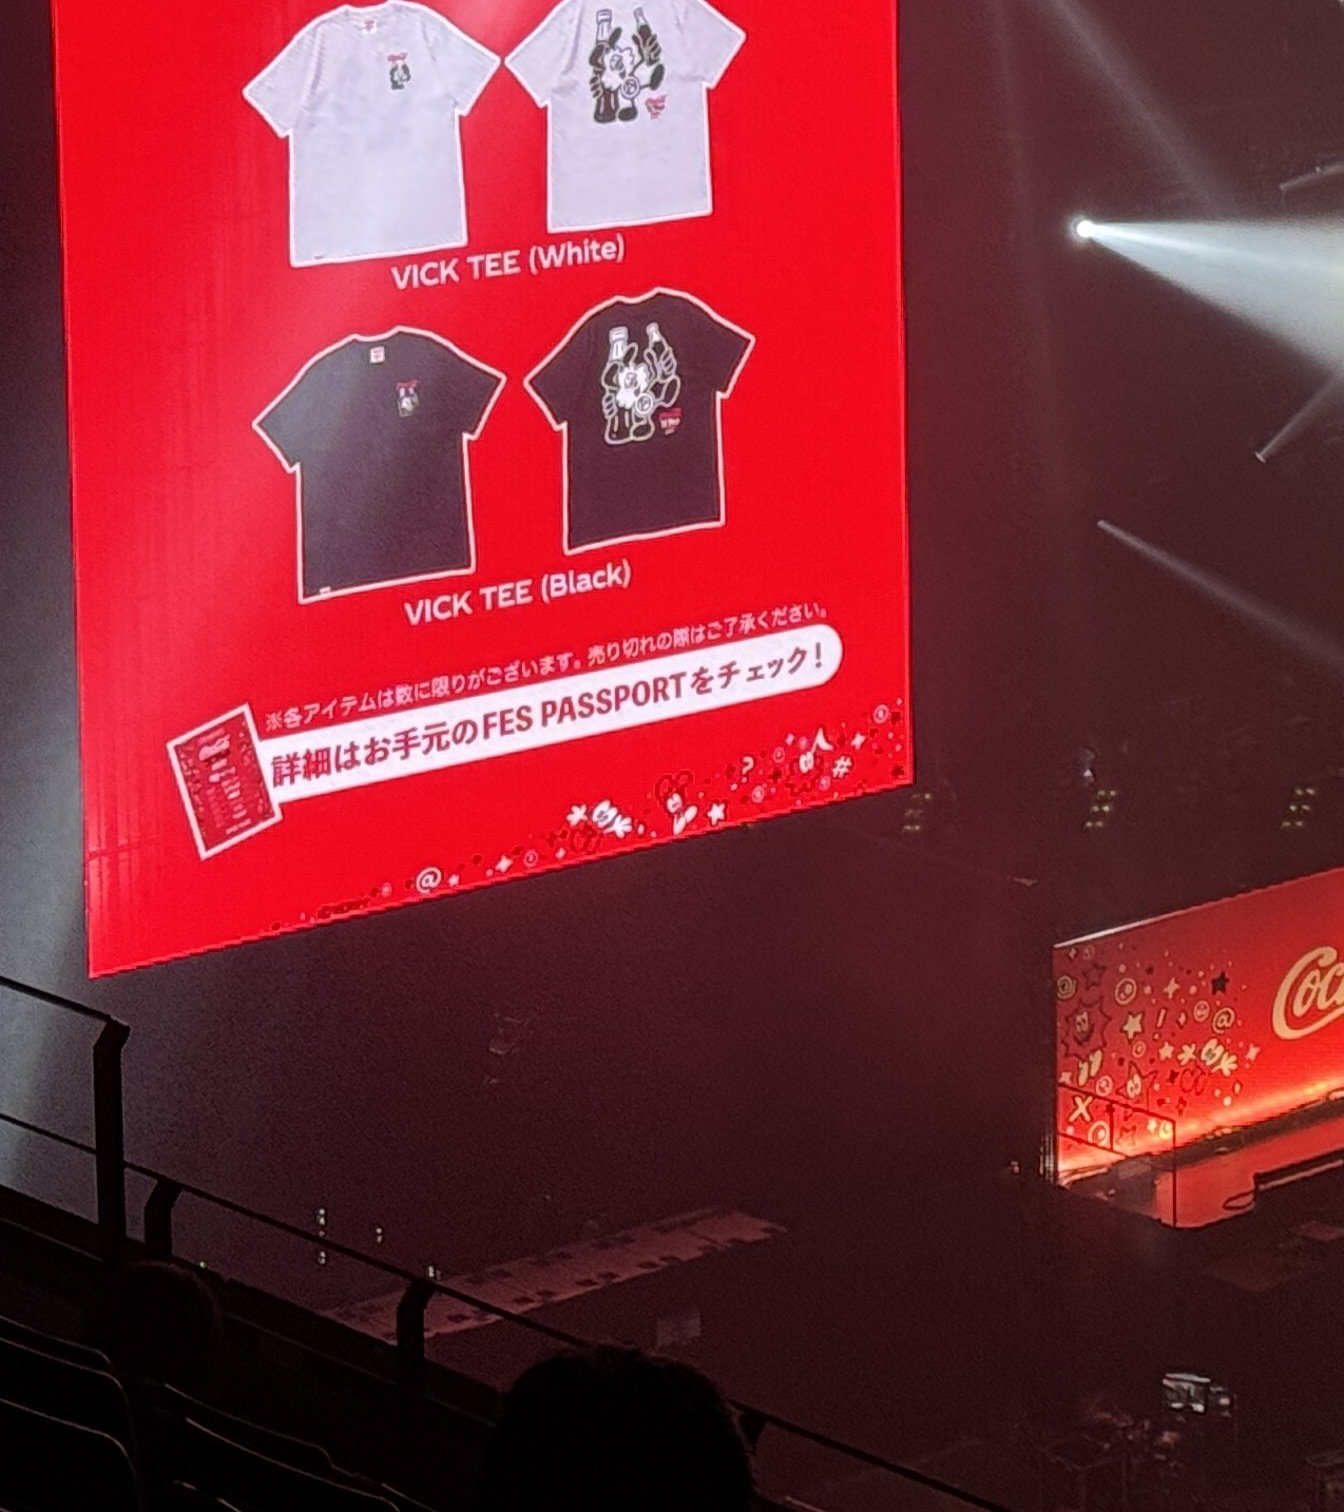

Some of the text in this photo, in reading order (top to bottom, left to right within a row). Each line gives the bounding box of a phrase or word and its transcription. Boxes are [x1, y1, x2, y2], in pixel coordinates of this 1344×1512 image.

[391, 232, 625, 291] VICK TEE (White)
[403, 558, 632, 626] VICK TEE (Black)
